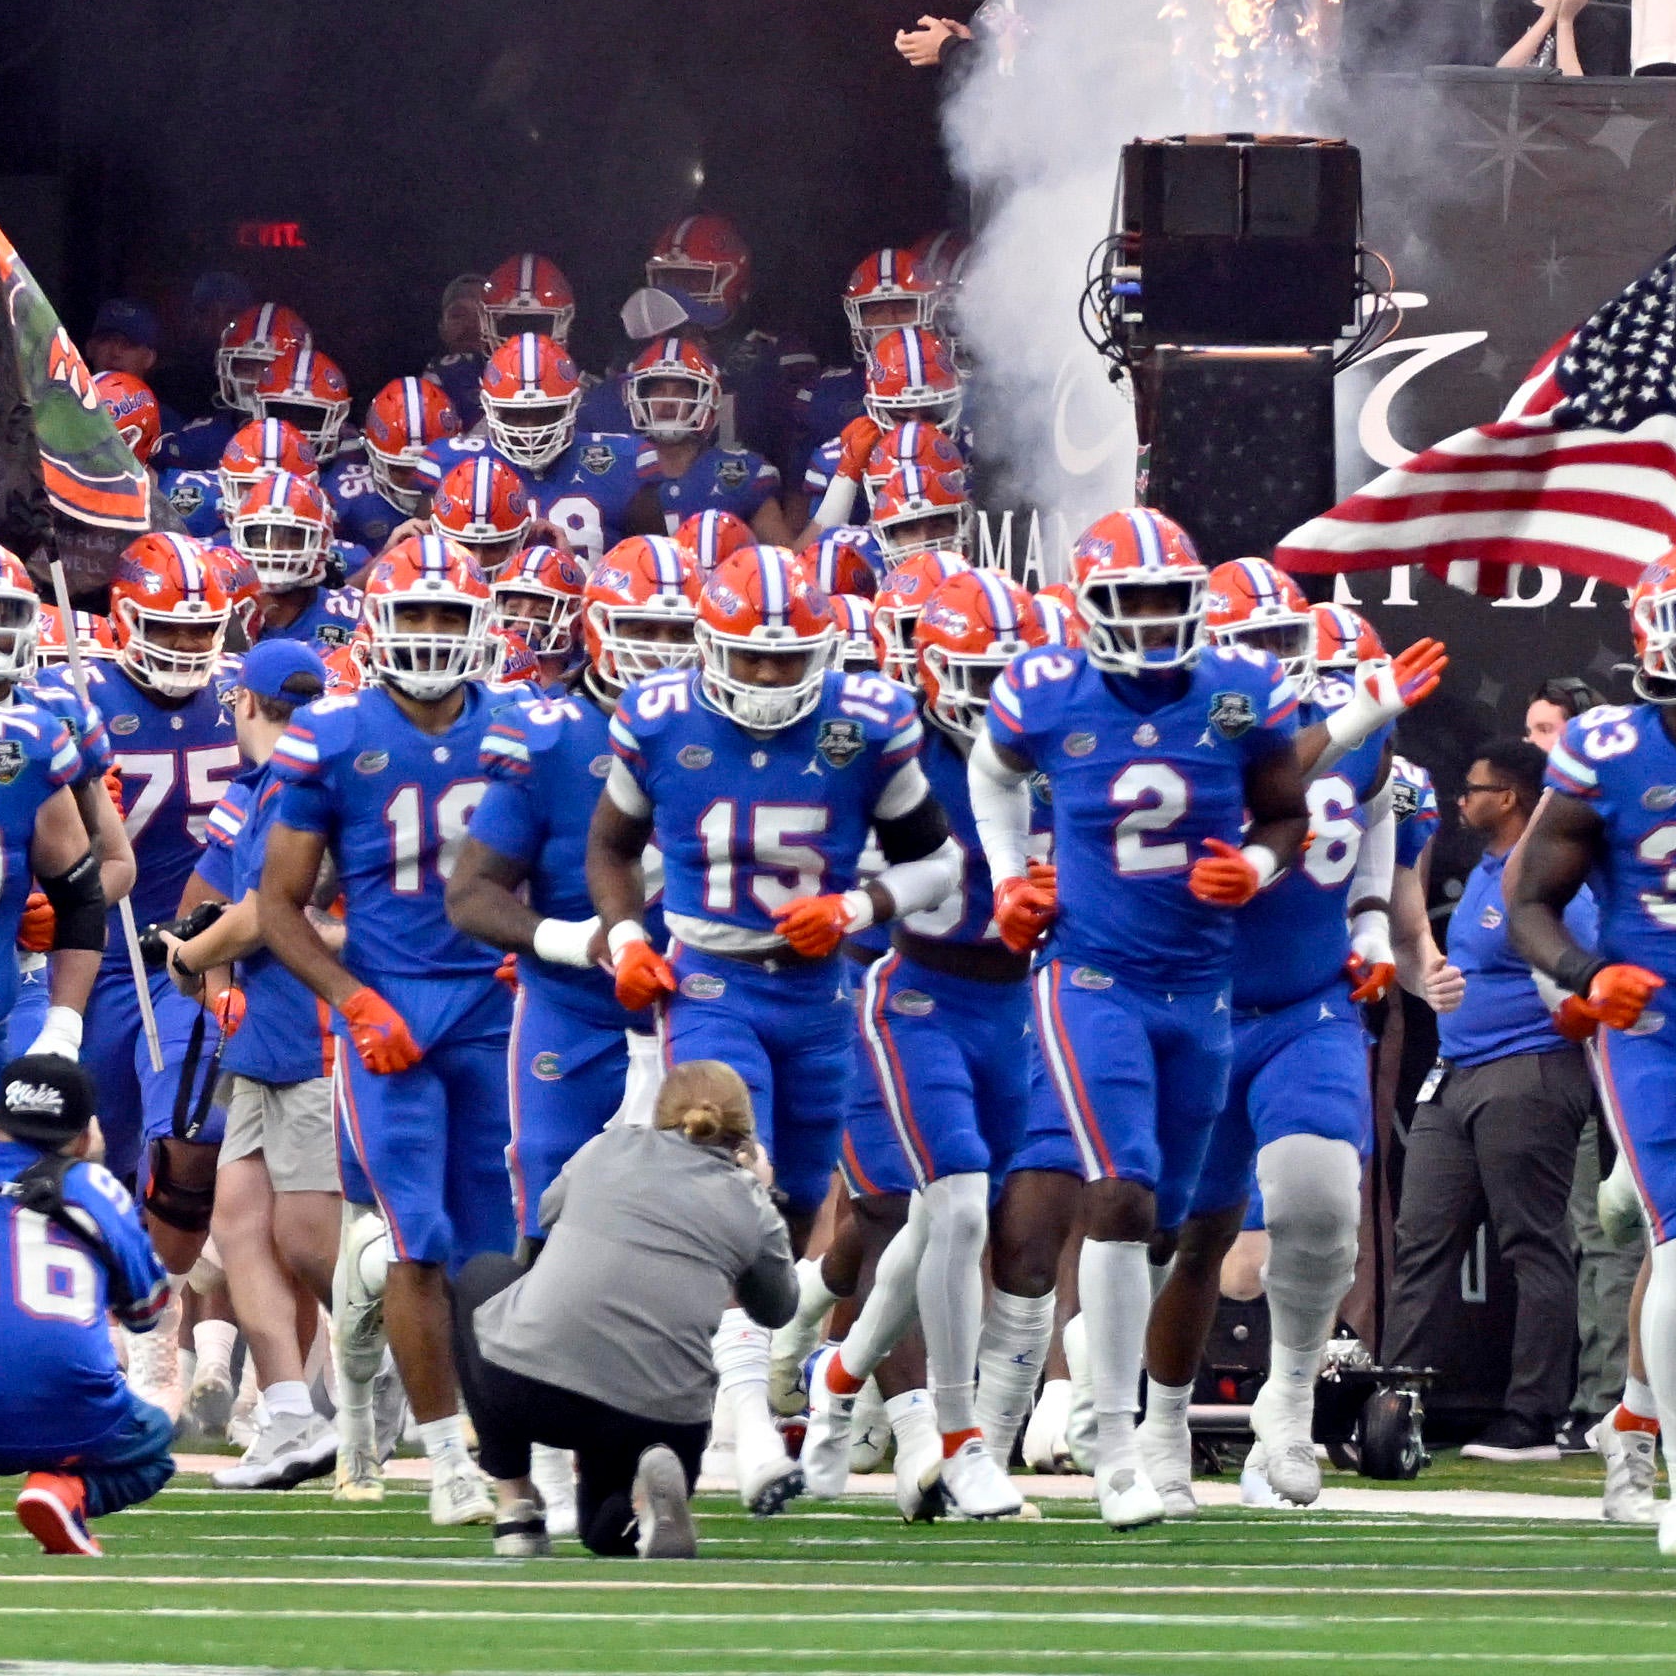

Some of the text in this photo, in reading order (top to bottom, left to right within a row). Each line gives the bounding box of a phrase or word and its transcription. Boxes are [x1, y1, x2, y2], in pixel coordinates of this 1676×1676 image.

[636, 672, 690, 721] 15
[840, 673, 896, 724] 15
[1023, 653, 1075, 689] 2
[112, 743, 242, 847] 75
[1109, 759, 1192, 874] 2
[698, 796, 830, 921] 15
